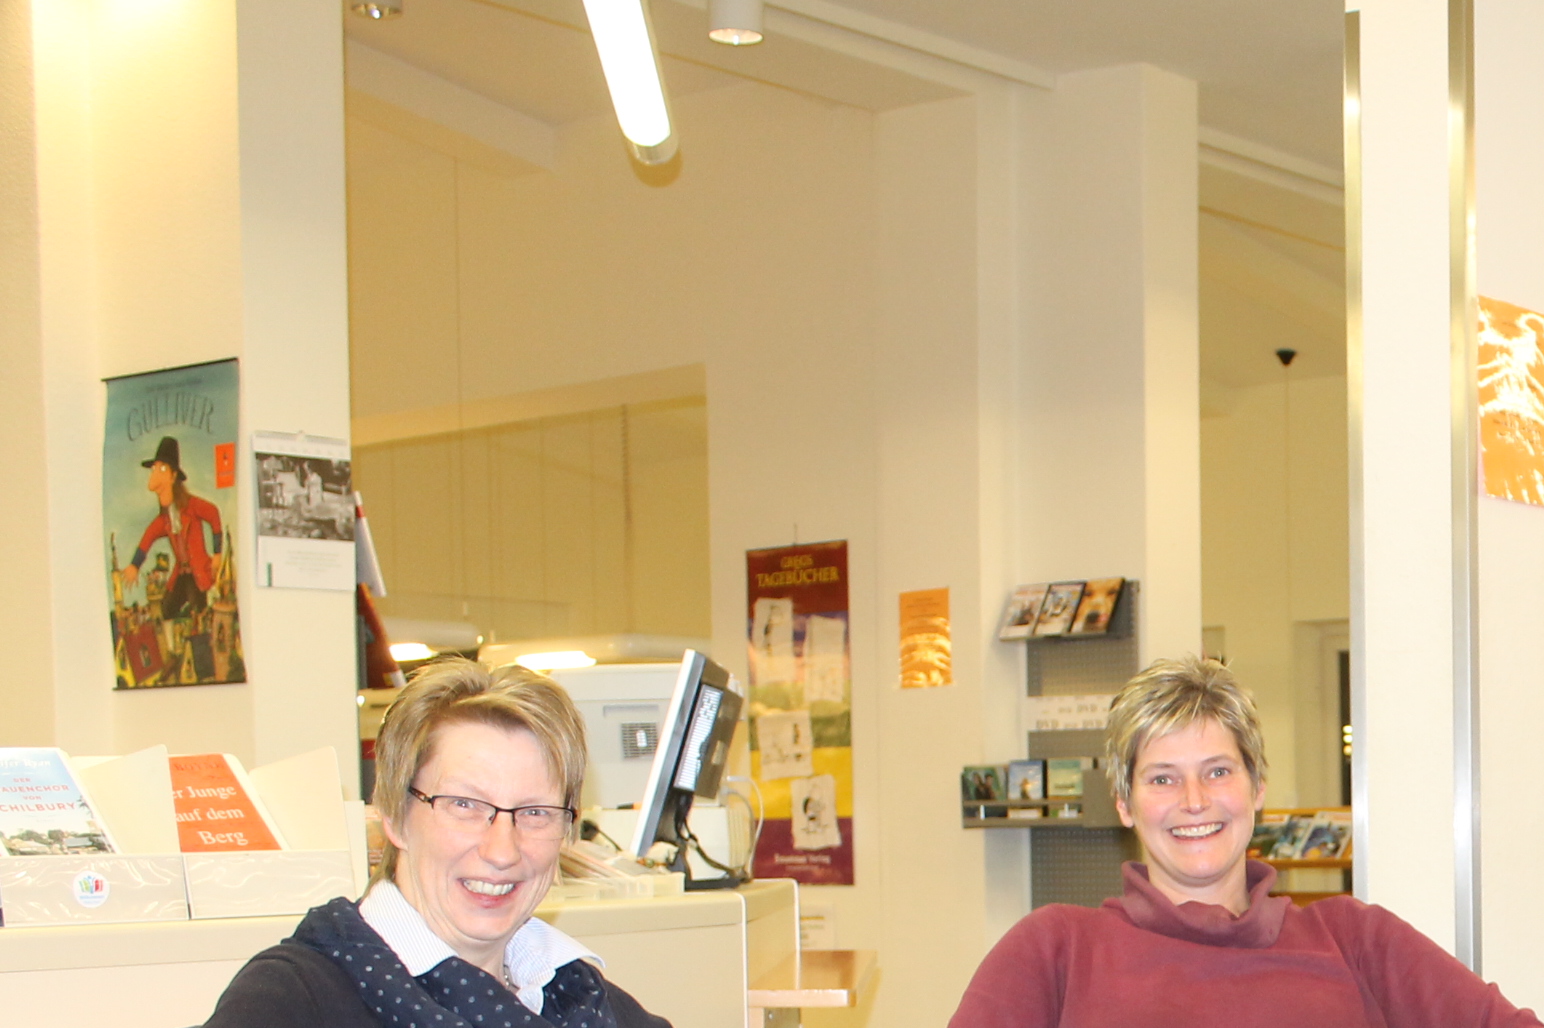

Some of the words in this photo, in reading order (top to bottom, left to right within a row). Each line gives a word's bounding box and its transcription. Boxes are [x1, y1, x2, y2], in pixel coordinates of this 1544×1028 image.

[126, 390, 214, 441] GULLIVER
[185, 785, 237, 800] Junge
[0, 802, 76, 812] CHILBURY
[176, 808, 203, 823] auf
[206, 807, 245, 820] dem
[197, 830, 249, 846] Berg
